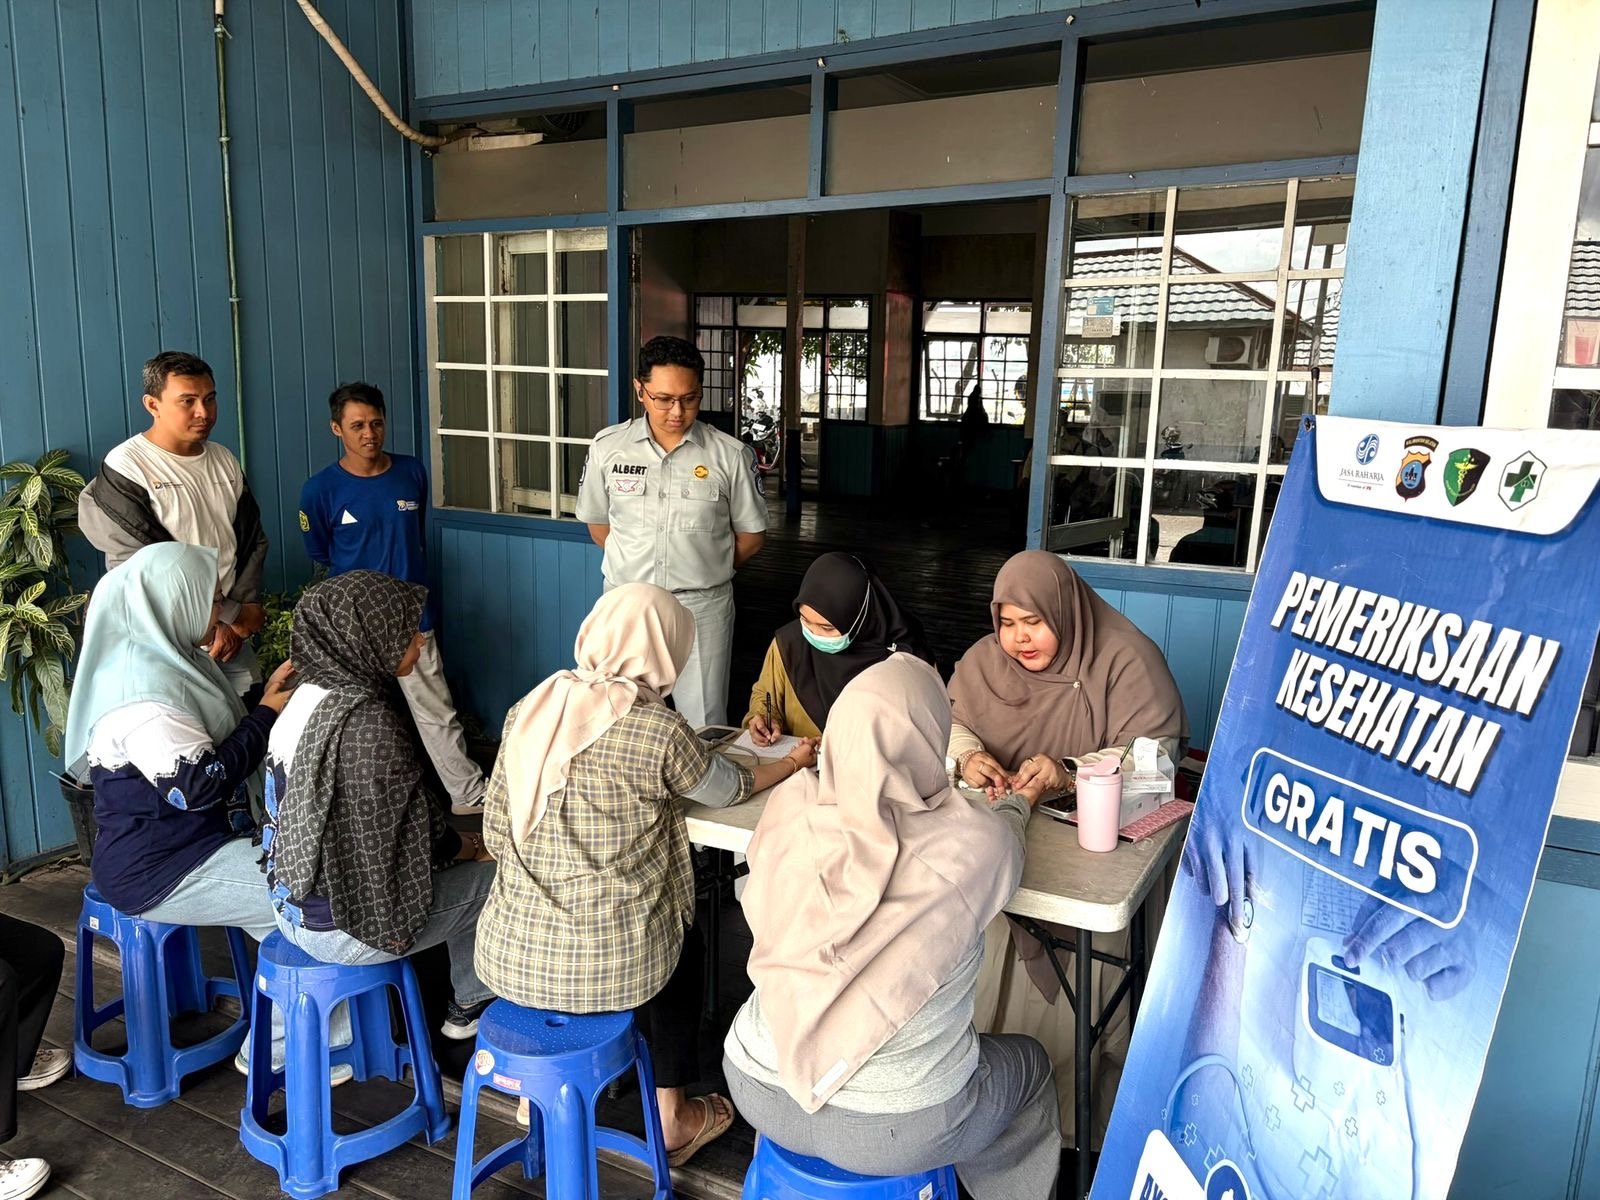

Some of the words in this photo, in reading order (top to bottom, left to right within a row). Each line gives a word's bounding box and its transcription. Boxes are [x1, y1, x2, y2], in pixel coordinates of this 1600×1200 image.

[612, 463, 648, 476] ALBERT
[1339, 467, 1354, 477] JASA
[1355, 469, 1384, 482] RAHARJA
[1271, 571, 1561, 716] PEMERIKSAAN
[1275, 649, 1501, 793] KESEHATAN
[1264, 773, 1443, 894] GRATIS
